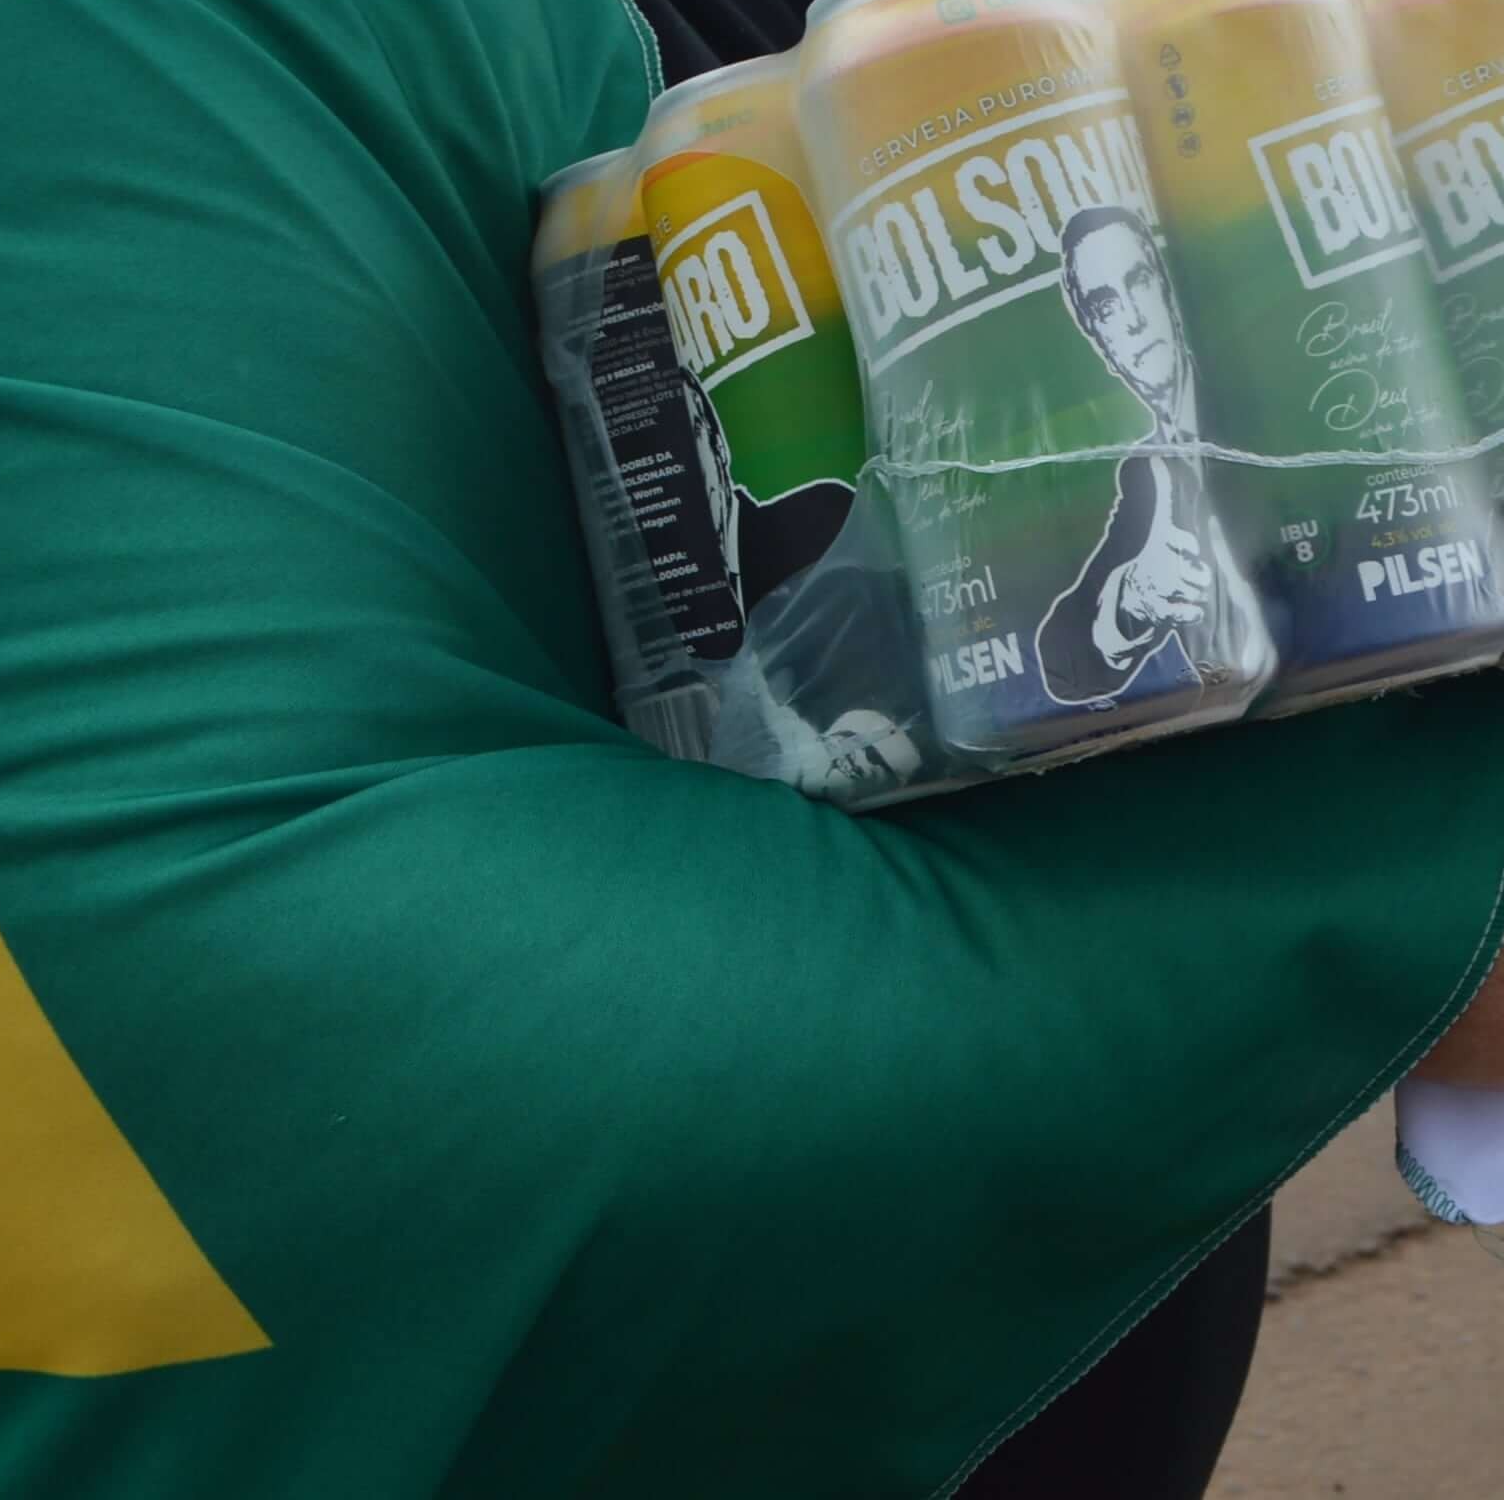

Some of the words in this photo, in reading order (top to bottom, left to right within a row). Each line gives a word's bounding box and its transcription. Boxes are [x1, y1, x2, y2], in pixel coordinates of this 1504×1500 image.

[858, 107, 974, 176] CERVEJA
[978, 76, 1057, 117] PURO
[1285, 116, 1416, 256] BOL
[624, 464, 686, 488] OLSONARO:
[1354, 475, 1459, 525] 473ml
[1279, 519, 1320, 543] IBU
[1295, 540, 1315, 563] 8
[1356, 539, 1485, 603] PILSEN
